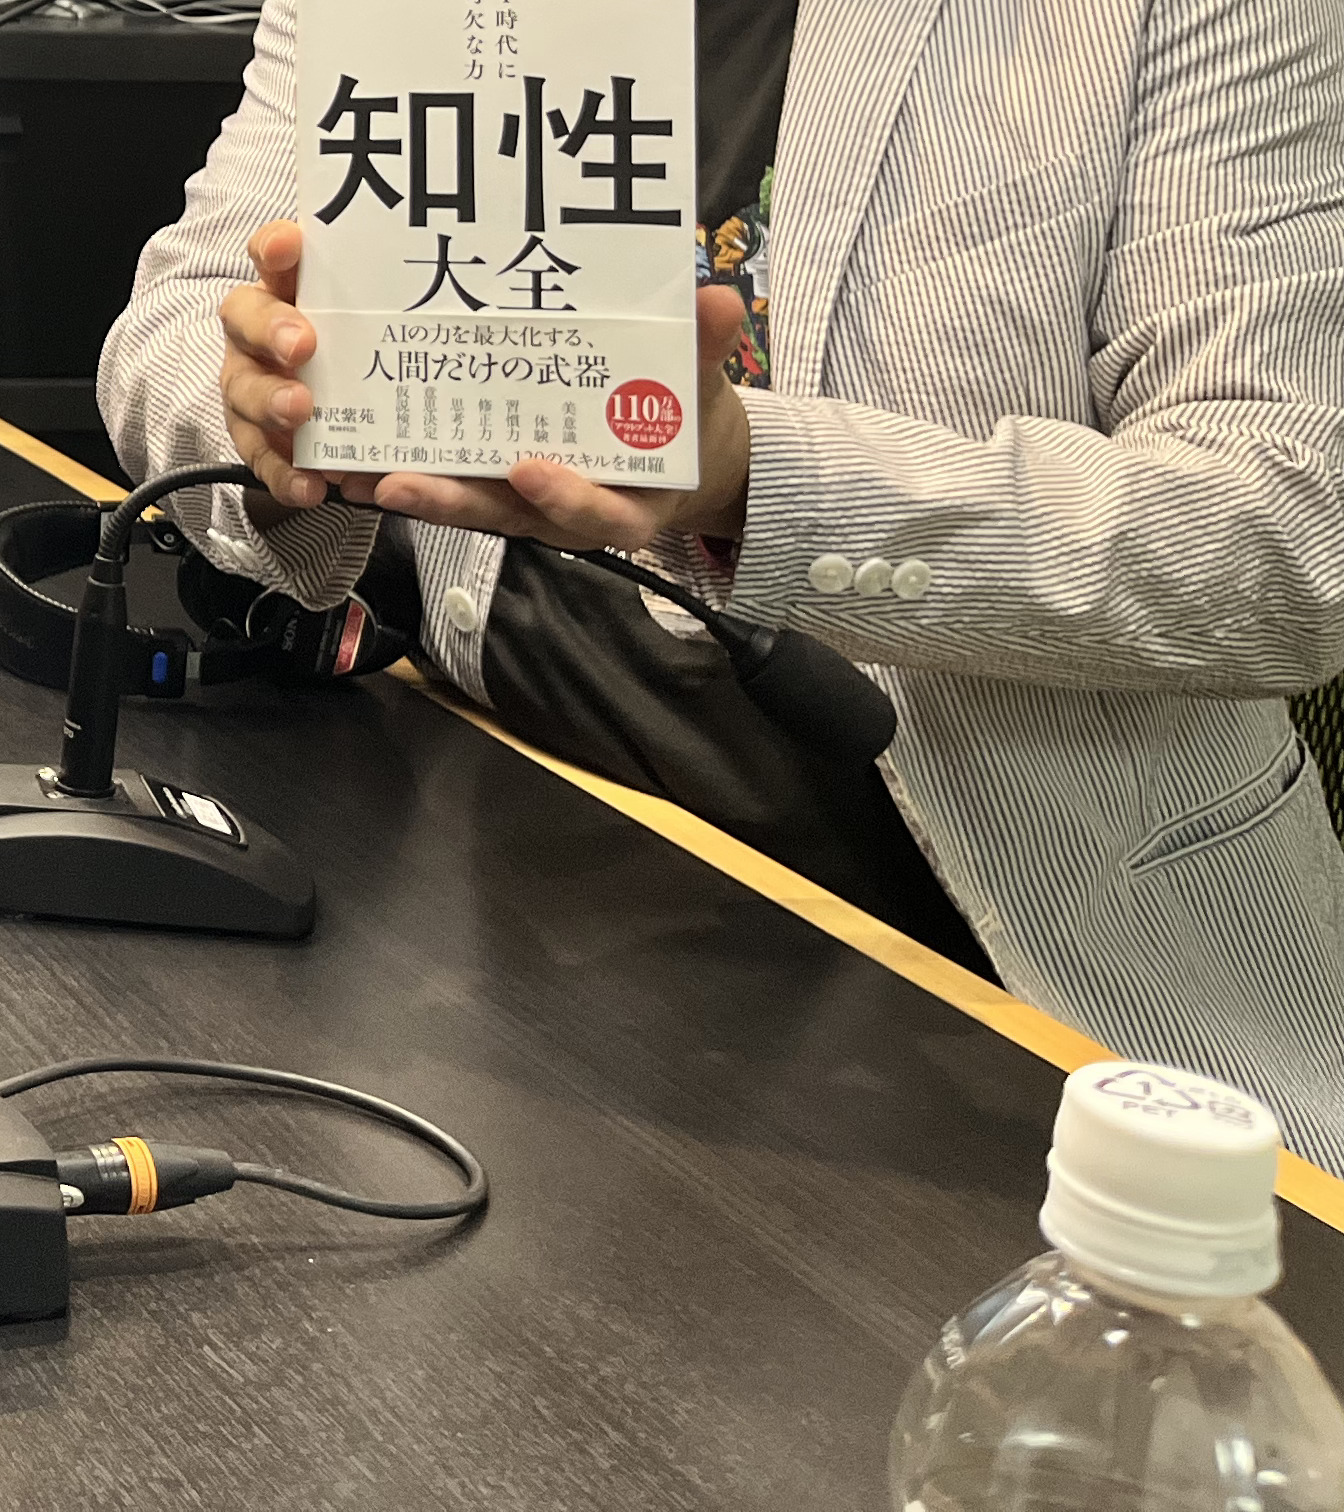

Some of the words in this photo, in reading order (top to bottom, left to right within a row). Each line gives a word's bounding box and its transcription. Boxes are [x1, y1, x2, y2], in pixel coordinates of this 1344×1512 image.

[313, 73, 683, 233] 知性
[402, 233, 583, 313] 大全
[380, 323, 595, 349] AIの力を最大化する、
[362, 349, 612, 389] 人間だけの武器
[395, 384, 411, 439] 仮説検証
[422, 385, 439, 441] 意思決定
[449, 397, 465, 441] 思考力
[477, 397, 493, 442] 修正力
